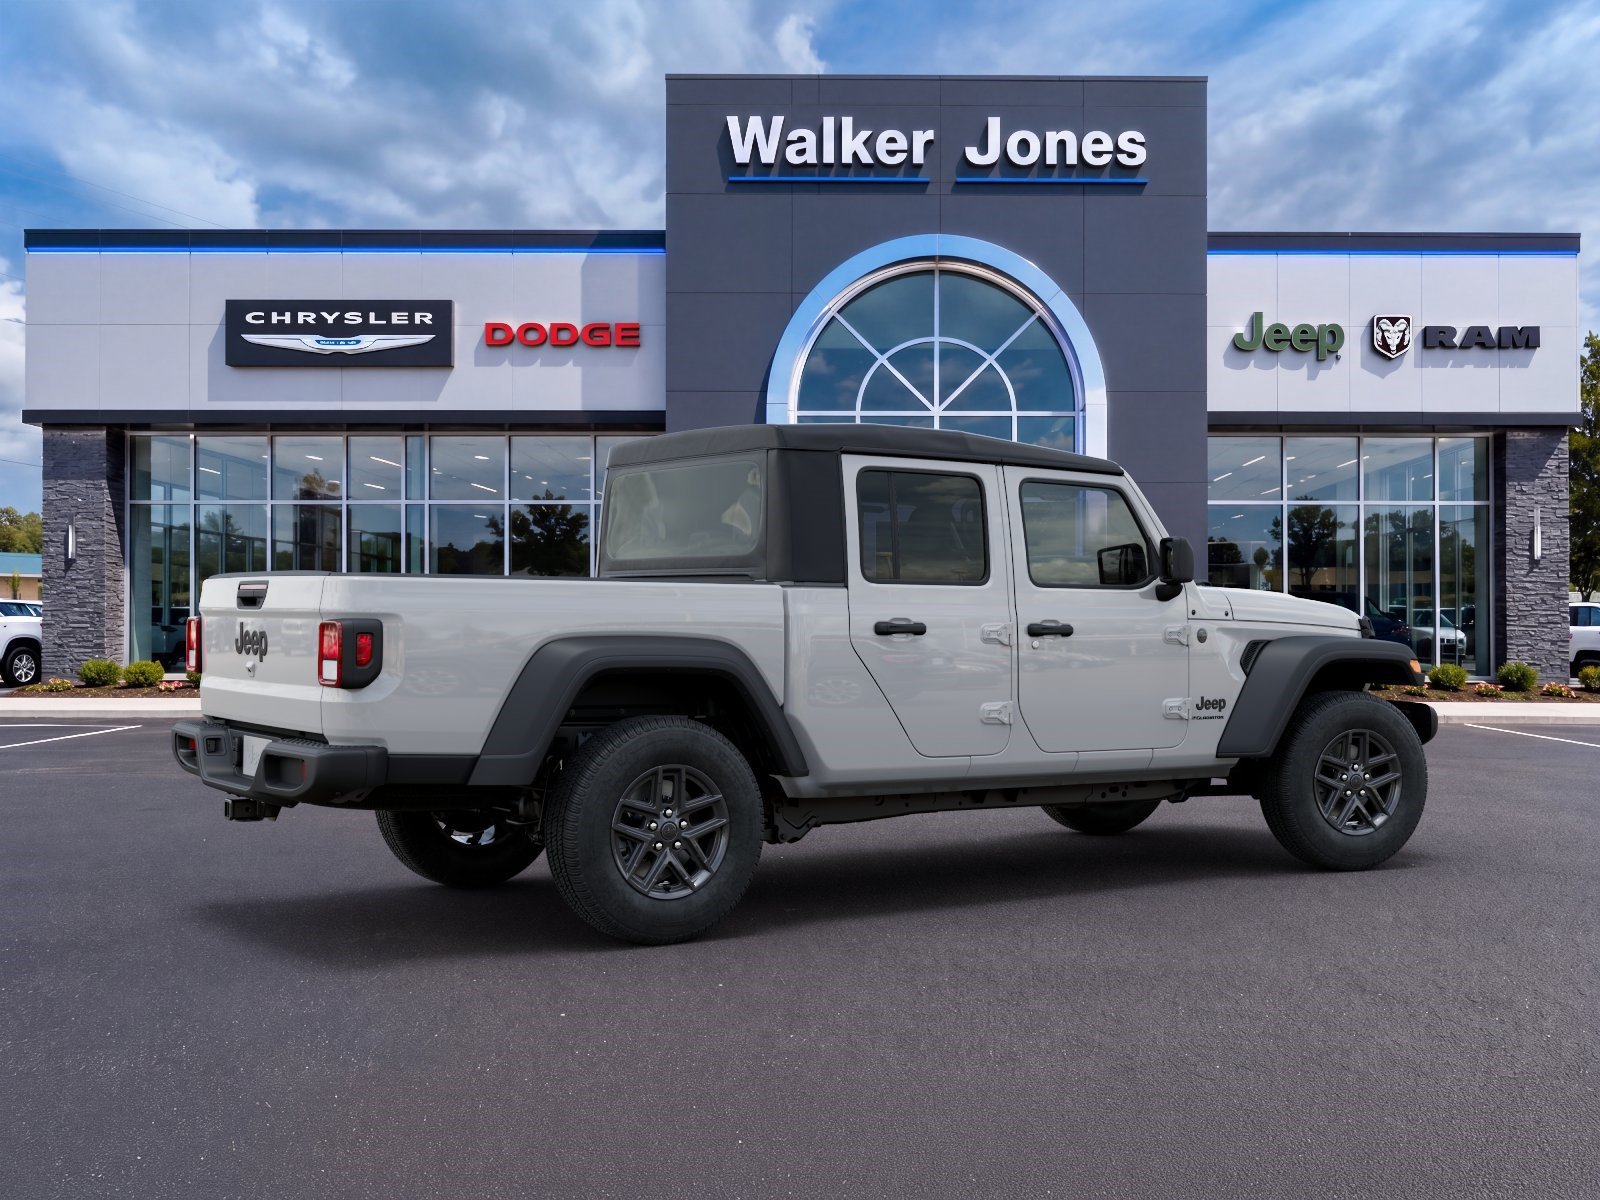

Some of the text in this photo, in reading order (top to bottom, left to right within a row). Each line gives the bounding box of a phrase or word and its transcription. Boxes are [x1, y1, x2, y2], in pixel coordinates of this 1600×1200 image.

[726, 115, 1147, 166] Walker Jones
[245, 311, 433, 325] CHRYSLER
[485, 322, 640, 347] DODGE
[1234, 312, 1344, 360] Jeep
[1424, 325, 1541, 349] RAM
[235, 621, 268, 662] Jeep
[1195, 696, 1226, 712] Jeep
